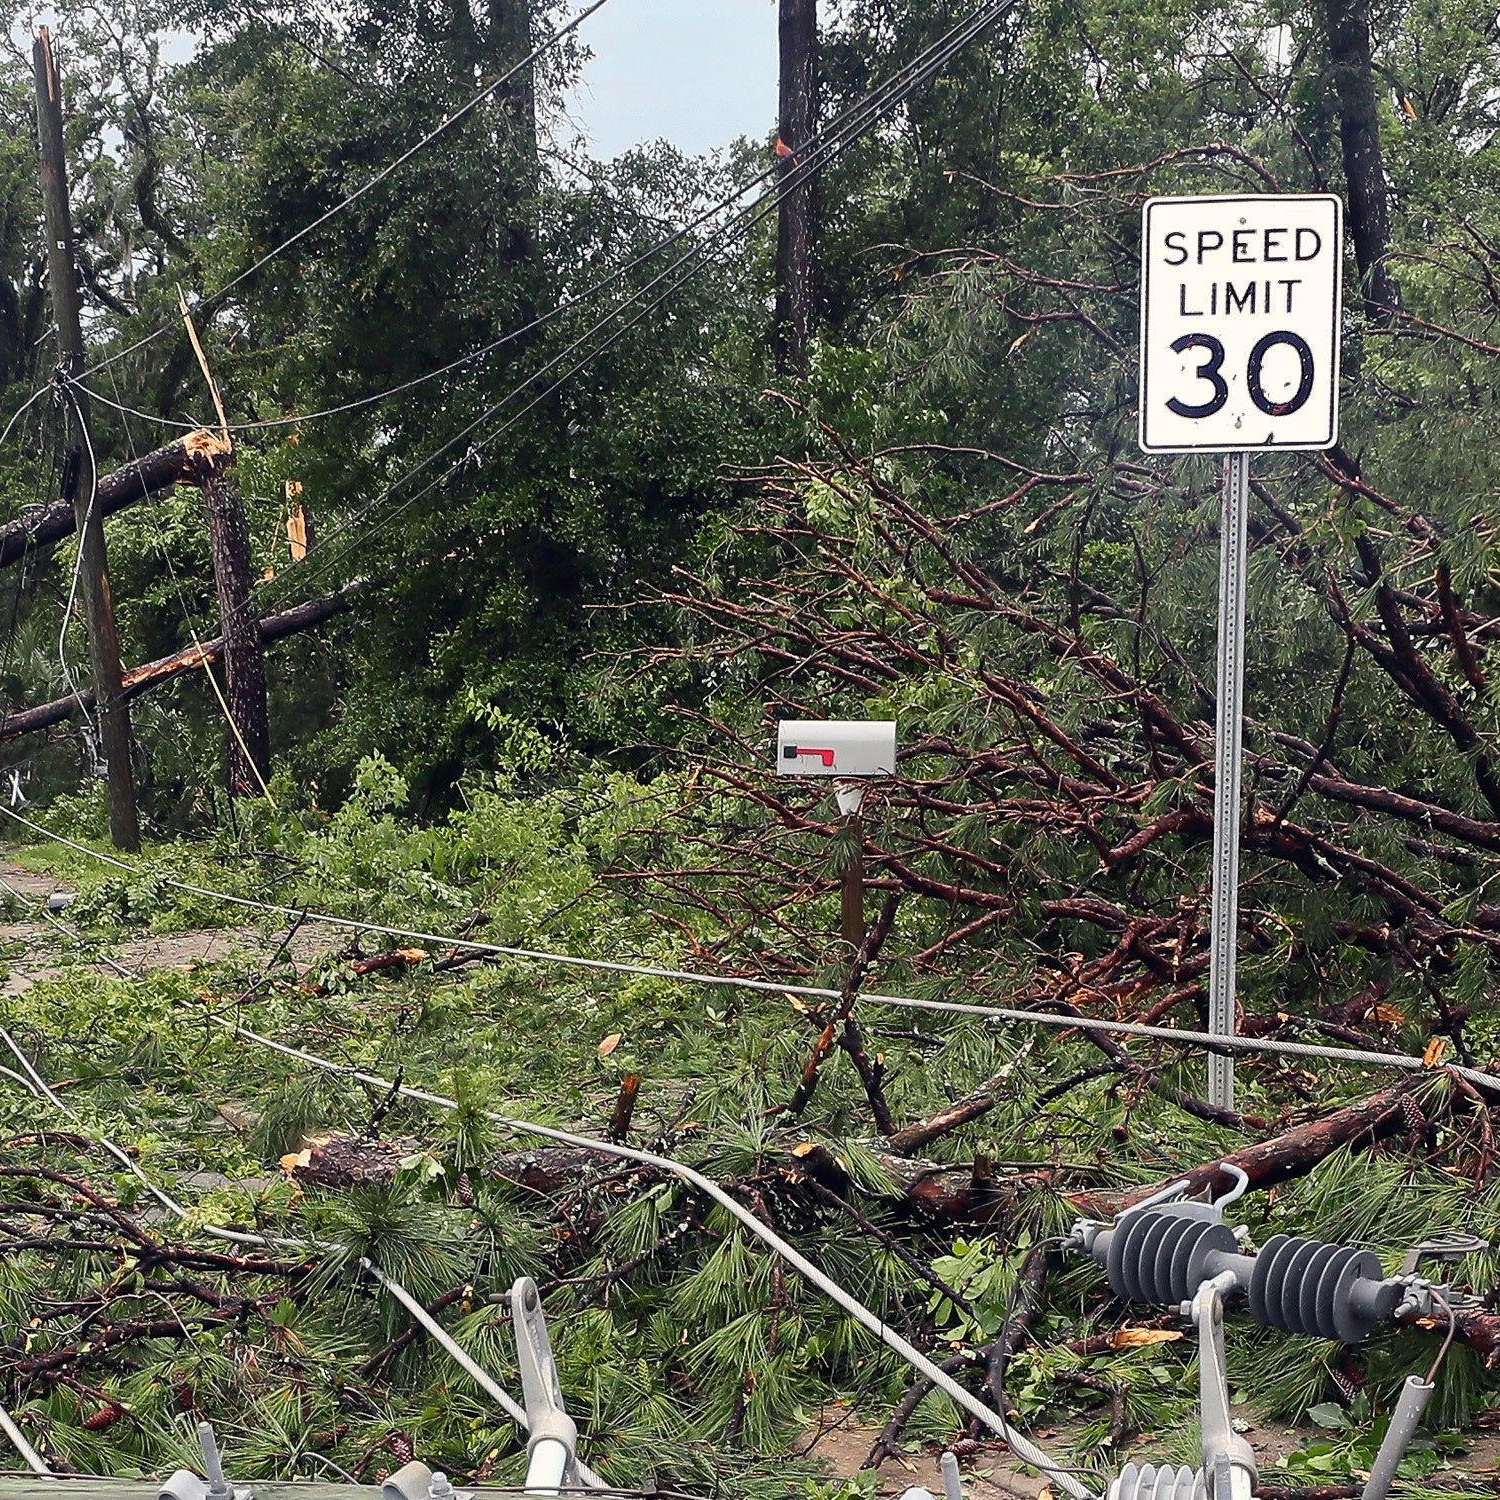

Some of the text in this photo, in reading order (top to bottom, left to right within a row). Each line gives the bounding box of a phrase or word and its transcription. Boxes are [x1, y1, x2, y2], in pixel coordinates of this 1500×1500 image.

[1163, 227, 1322, 266] SPEED
[1179, 279, 1302, 316] LIMIT
[1164, 330, 1315, 418] 30
